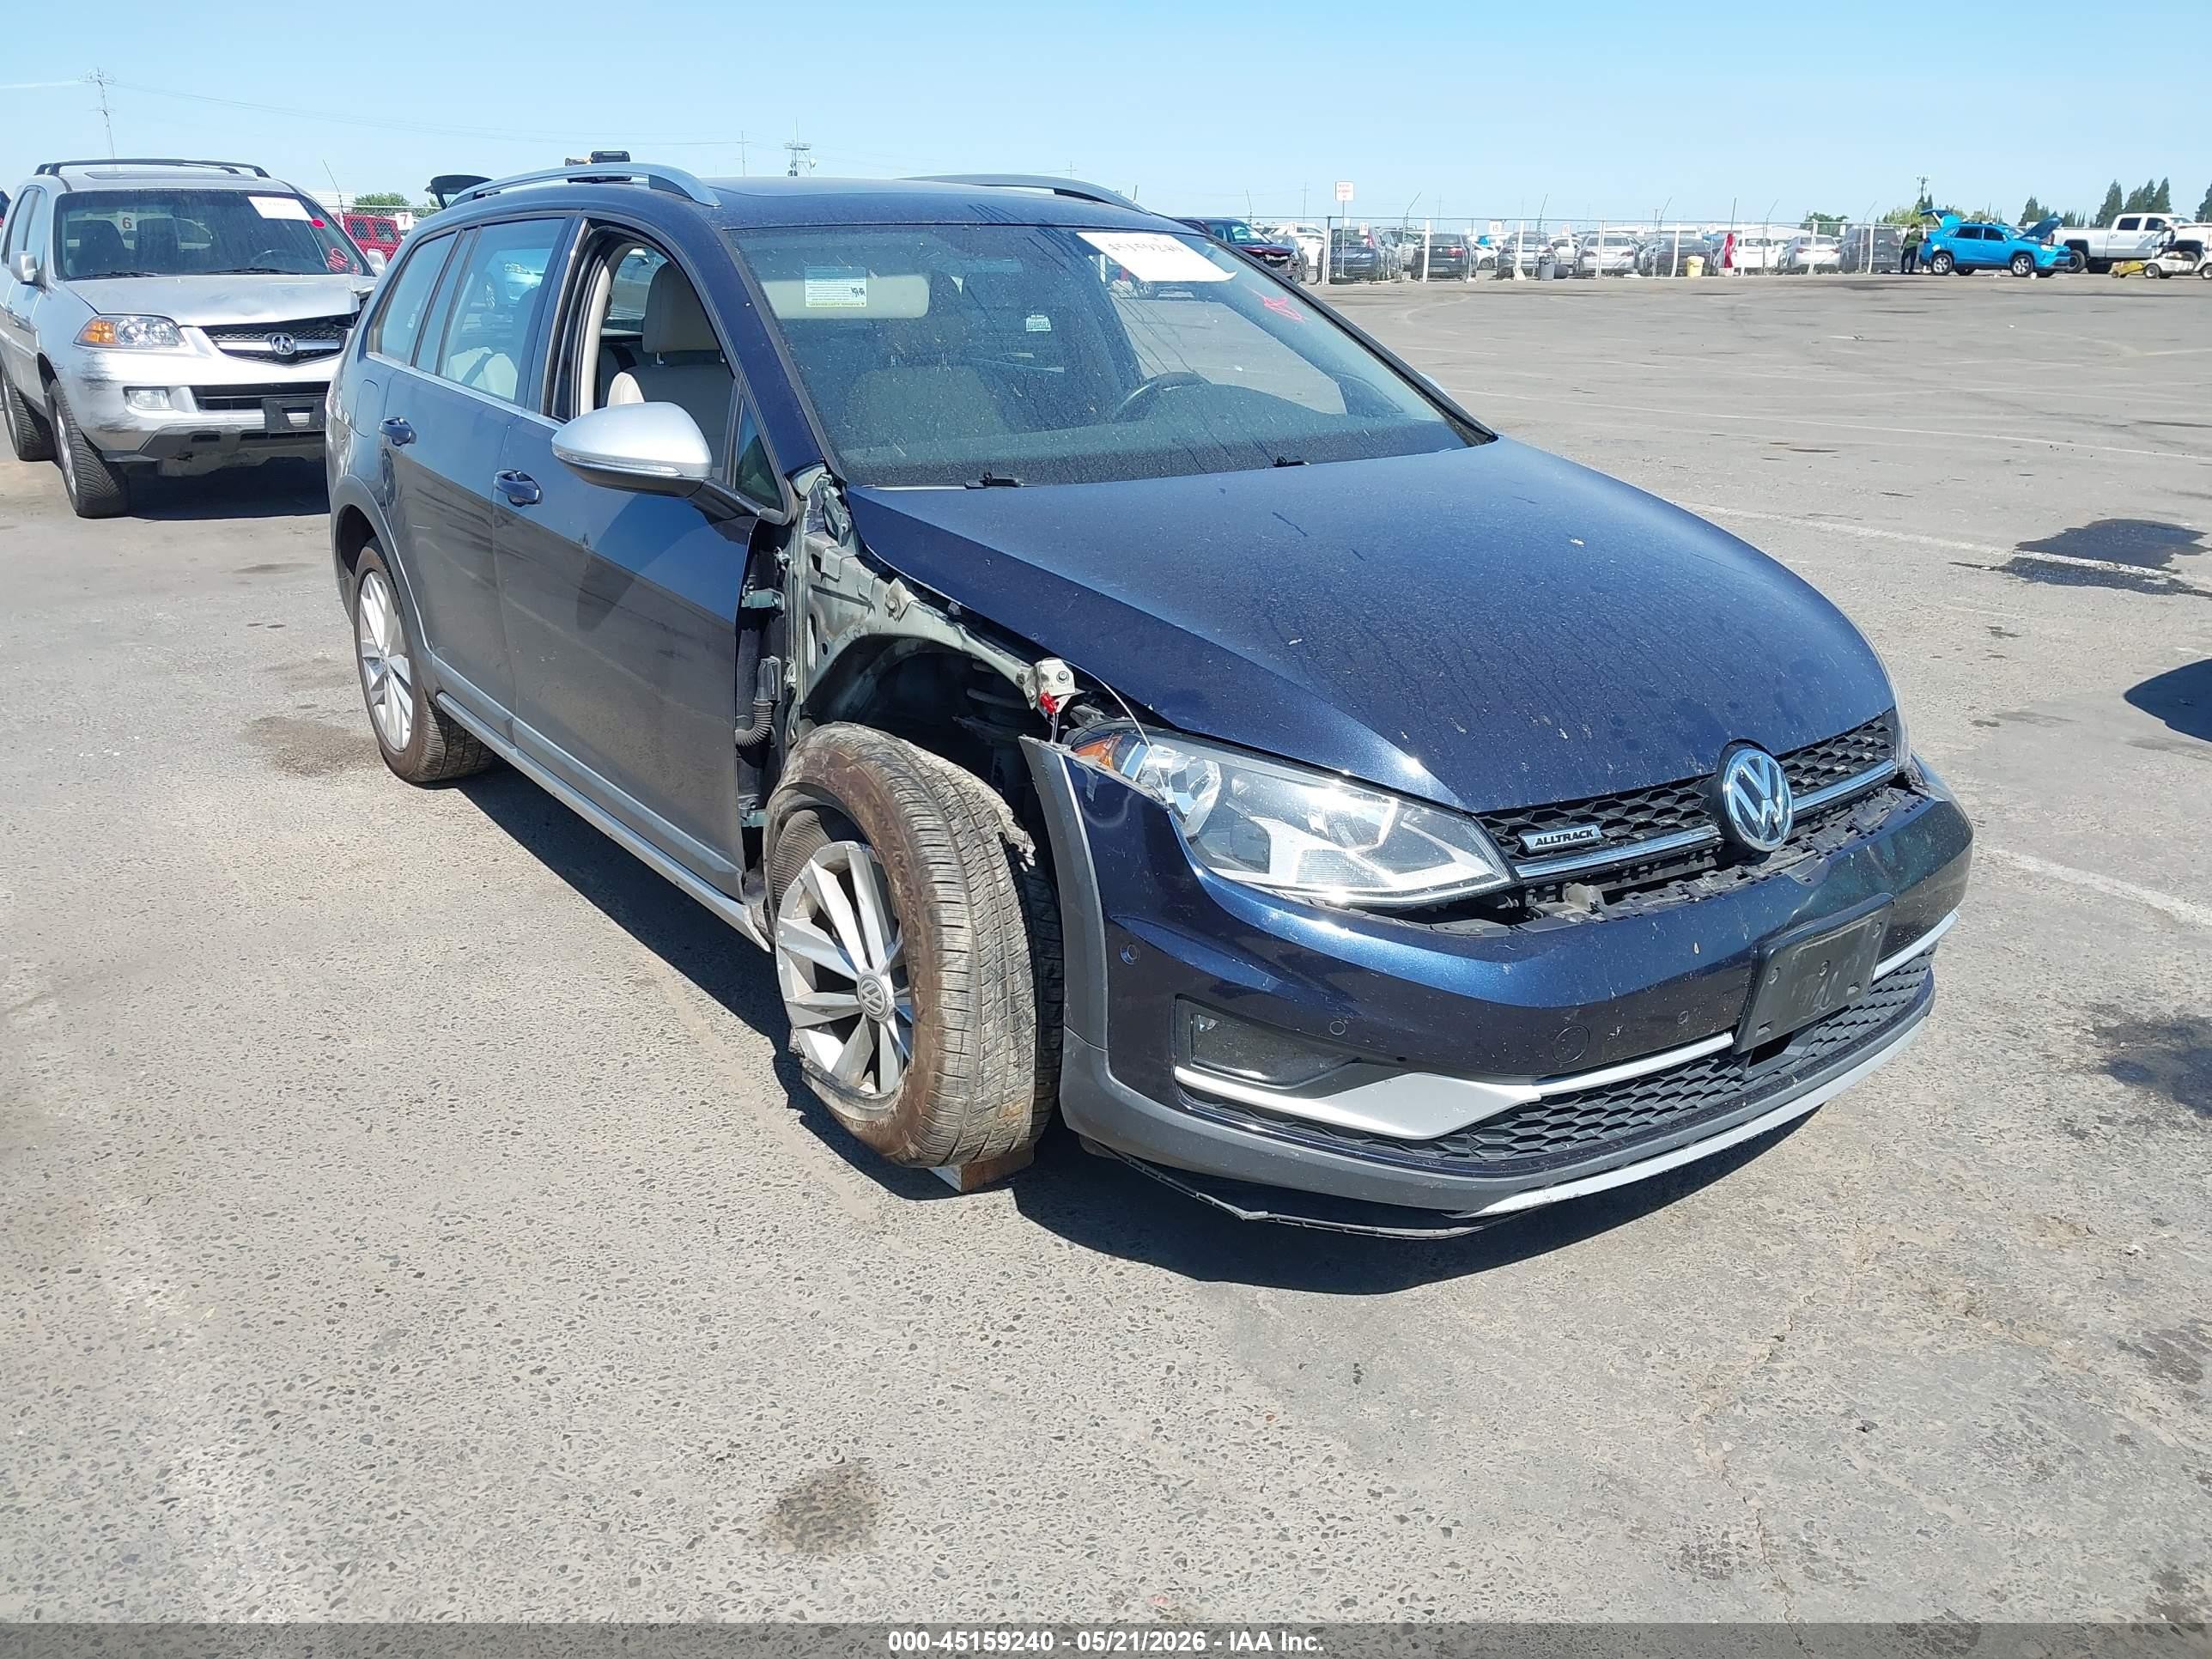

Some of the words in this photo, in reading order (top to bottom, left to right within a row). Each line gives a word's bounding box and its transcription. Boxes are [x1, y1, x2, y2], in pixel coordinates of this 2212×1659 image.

[122, 216, 133, 229] 6
[399, 214, 408, 226] 7
[1534, 829, 1595, 847] ALLTRACK
